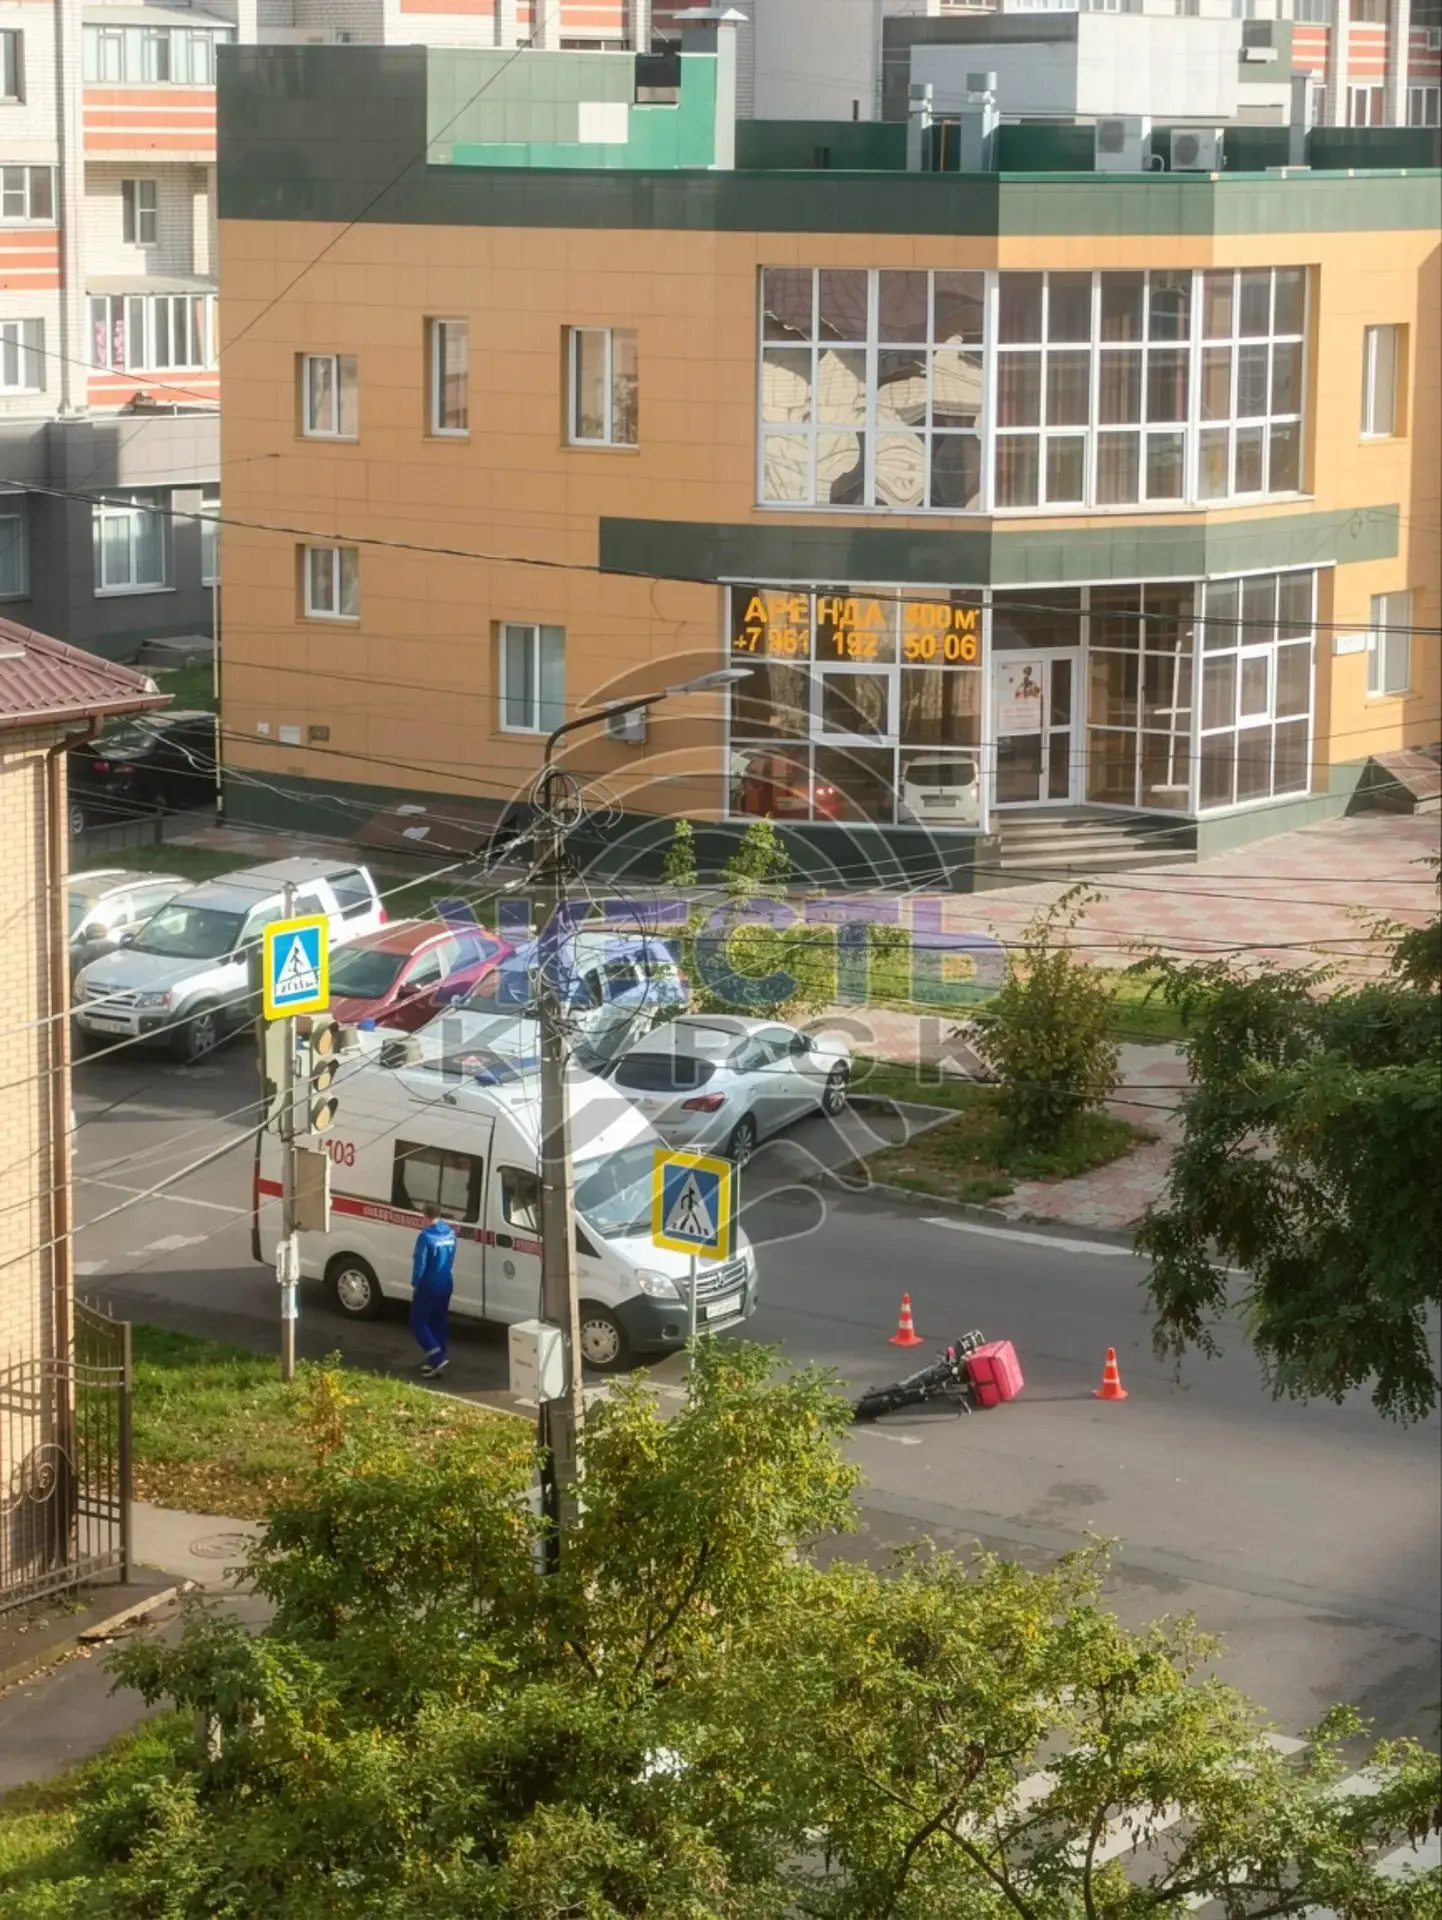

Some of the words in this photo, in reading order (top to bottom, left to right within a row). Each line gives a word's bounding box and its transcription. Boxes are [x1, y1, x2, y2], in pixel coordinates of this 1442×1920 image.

[744, 595, 886, 630] АРЕНДА
[733, 626, 762, 652] +7
[904, 632, 937, 660] 50
[944, 633, 977, 661] 06
[324, 1138, 356, 1167] 103
